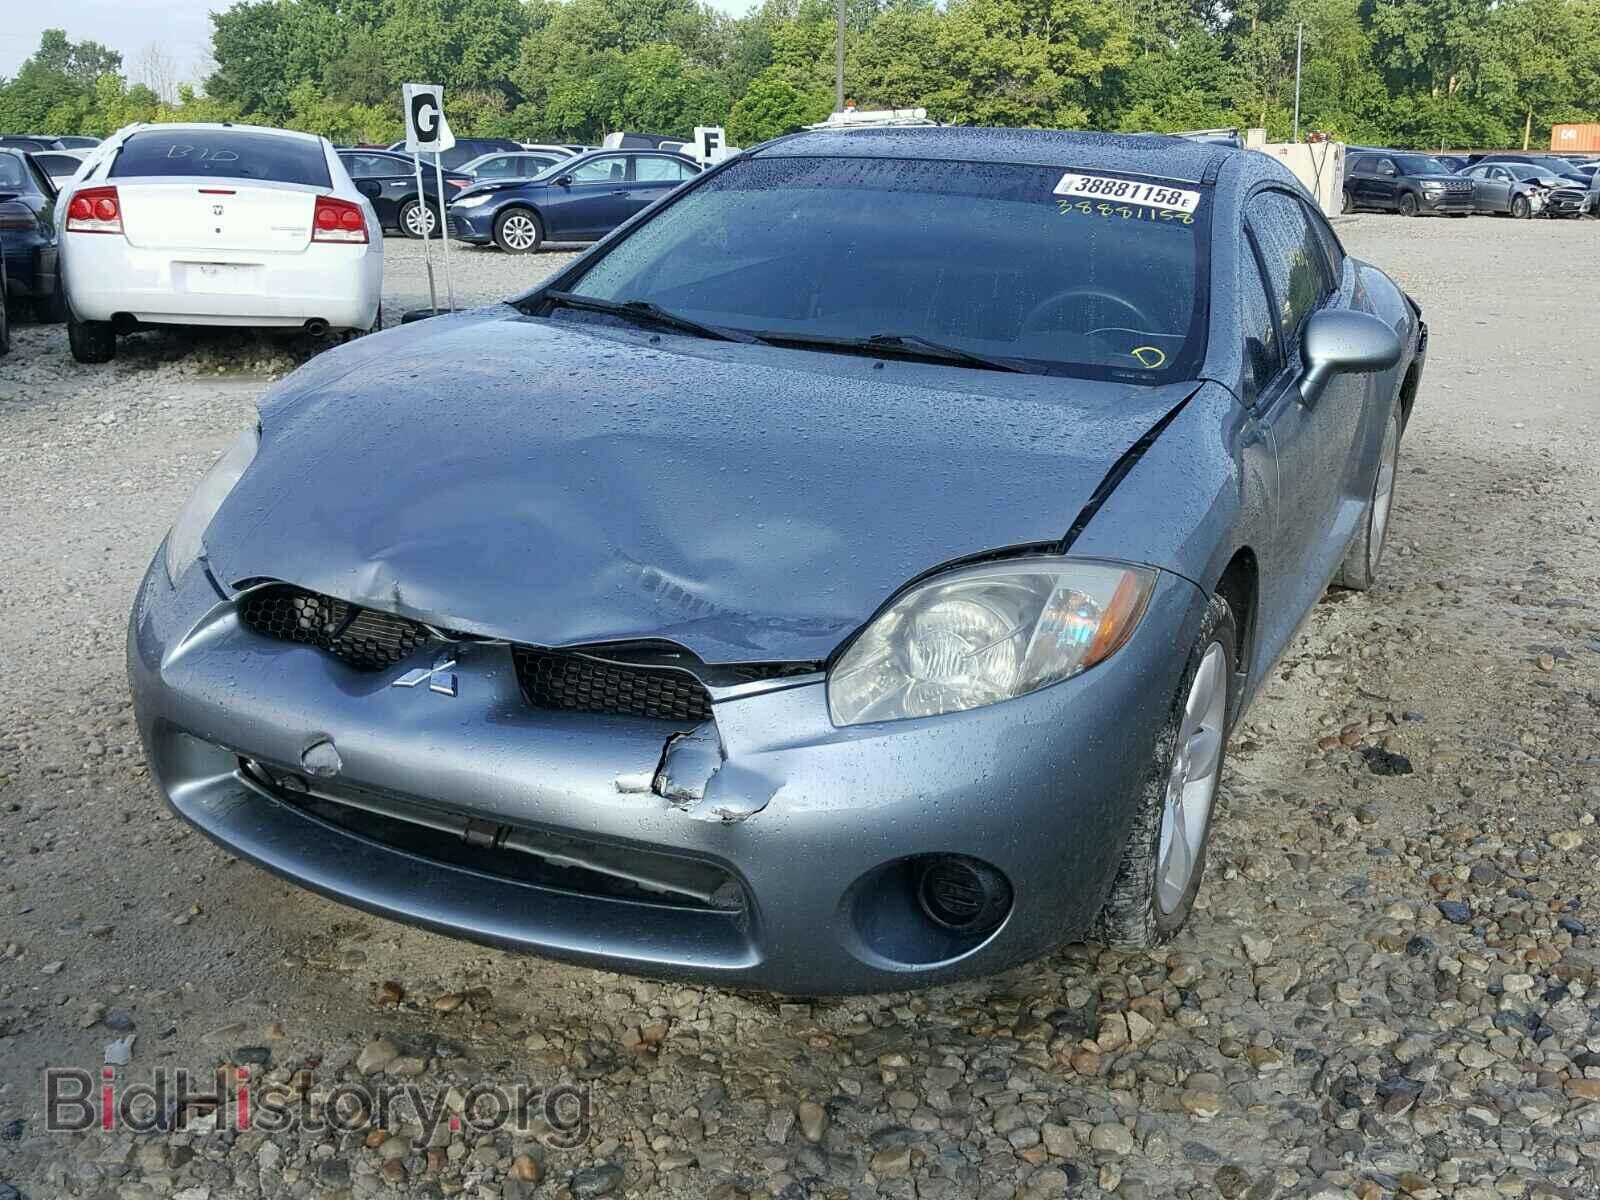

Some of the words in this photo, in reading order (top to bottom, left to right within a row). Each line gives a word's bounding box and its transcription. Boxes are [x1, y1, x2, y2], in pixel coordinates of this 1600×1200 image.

[412, 93, 440, 143] G
[704, 132, 719, 158] F
[1075, 177, 1182, 207] 38881158
[1181, 198, 1192, 208] E
[1056, 199, 1195, 225] 38881158
